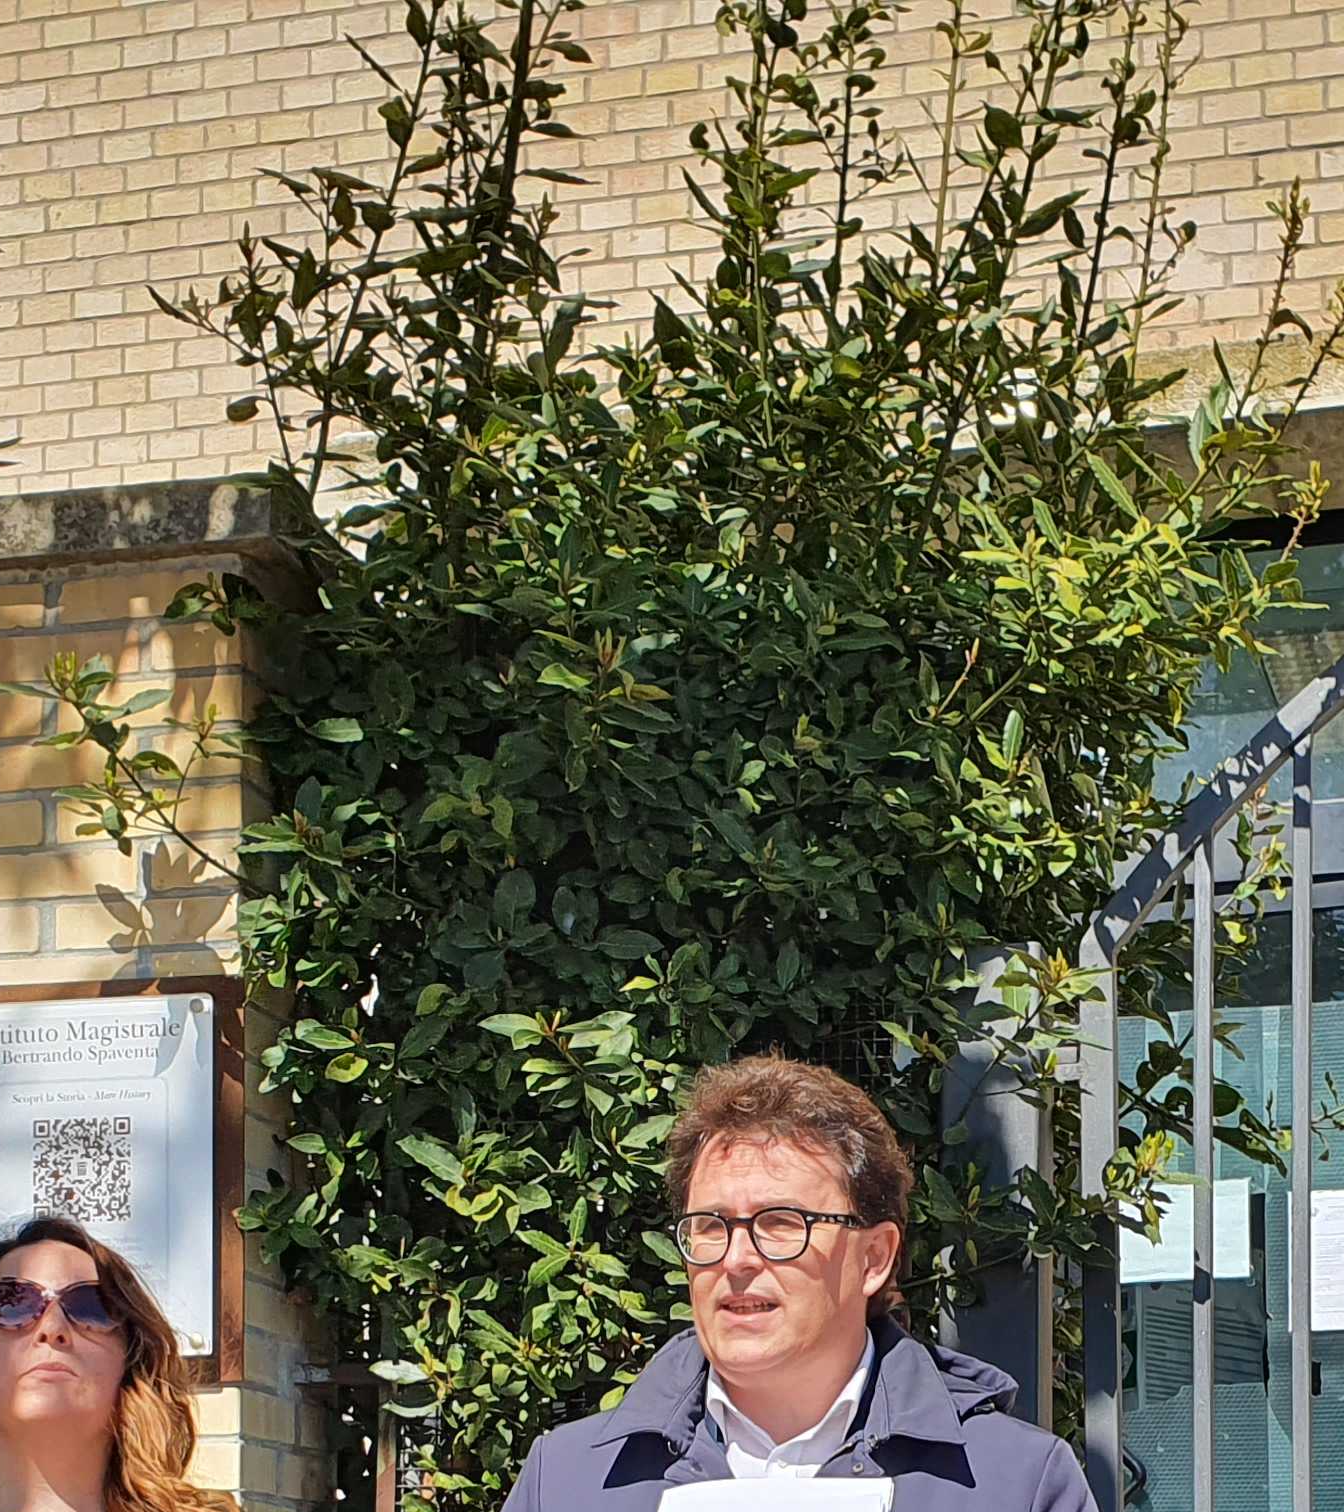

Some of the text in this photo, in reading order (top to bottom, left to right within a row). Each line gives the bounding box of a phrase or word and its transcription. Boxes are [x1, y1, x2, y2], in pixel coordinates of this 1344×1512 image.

[66, 1016, 181, 1047] Magistrale
[1, 1045, 160, 1066] Bertrando Spaventa
[11, 1093, 44, 1105] Scopri
[46, 1092, 55, 1102] la
[57, 1091, 86, 1102] Storia
